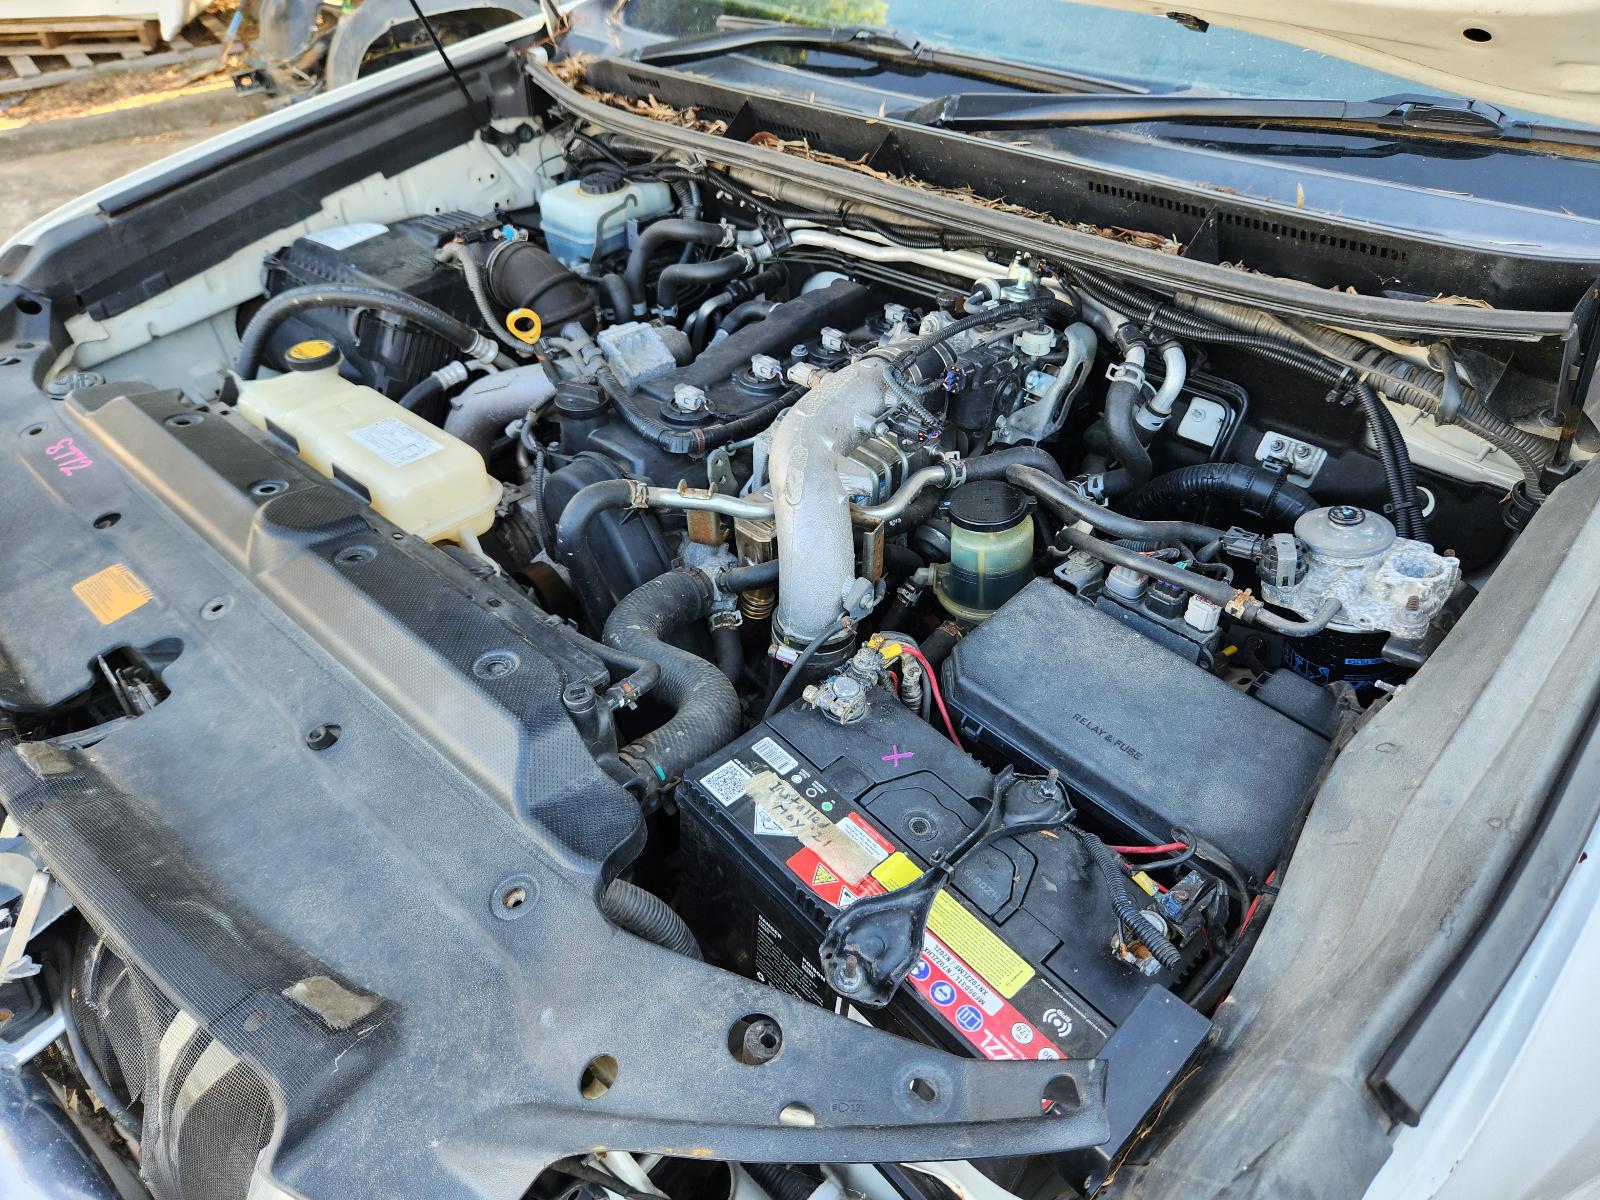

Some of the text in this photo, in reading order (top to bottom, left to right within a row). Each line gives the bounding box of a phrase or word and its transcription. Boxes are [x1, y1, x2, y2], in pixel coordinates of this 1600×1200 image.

[1072, 713, 1143, 760] RELAY & FUSE
[769, 781, 831, 829] Installed
[933, 944, 951, 962] N70ZL
[802, 956, 826, 982] POISON
[955, 977, 986, 1006] MF95D31L
[1057, 1009, 1073, 1023] RFID
